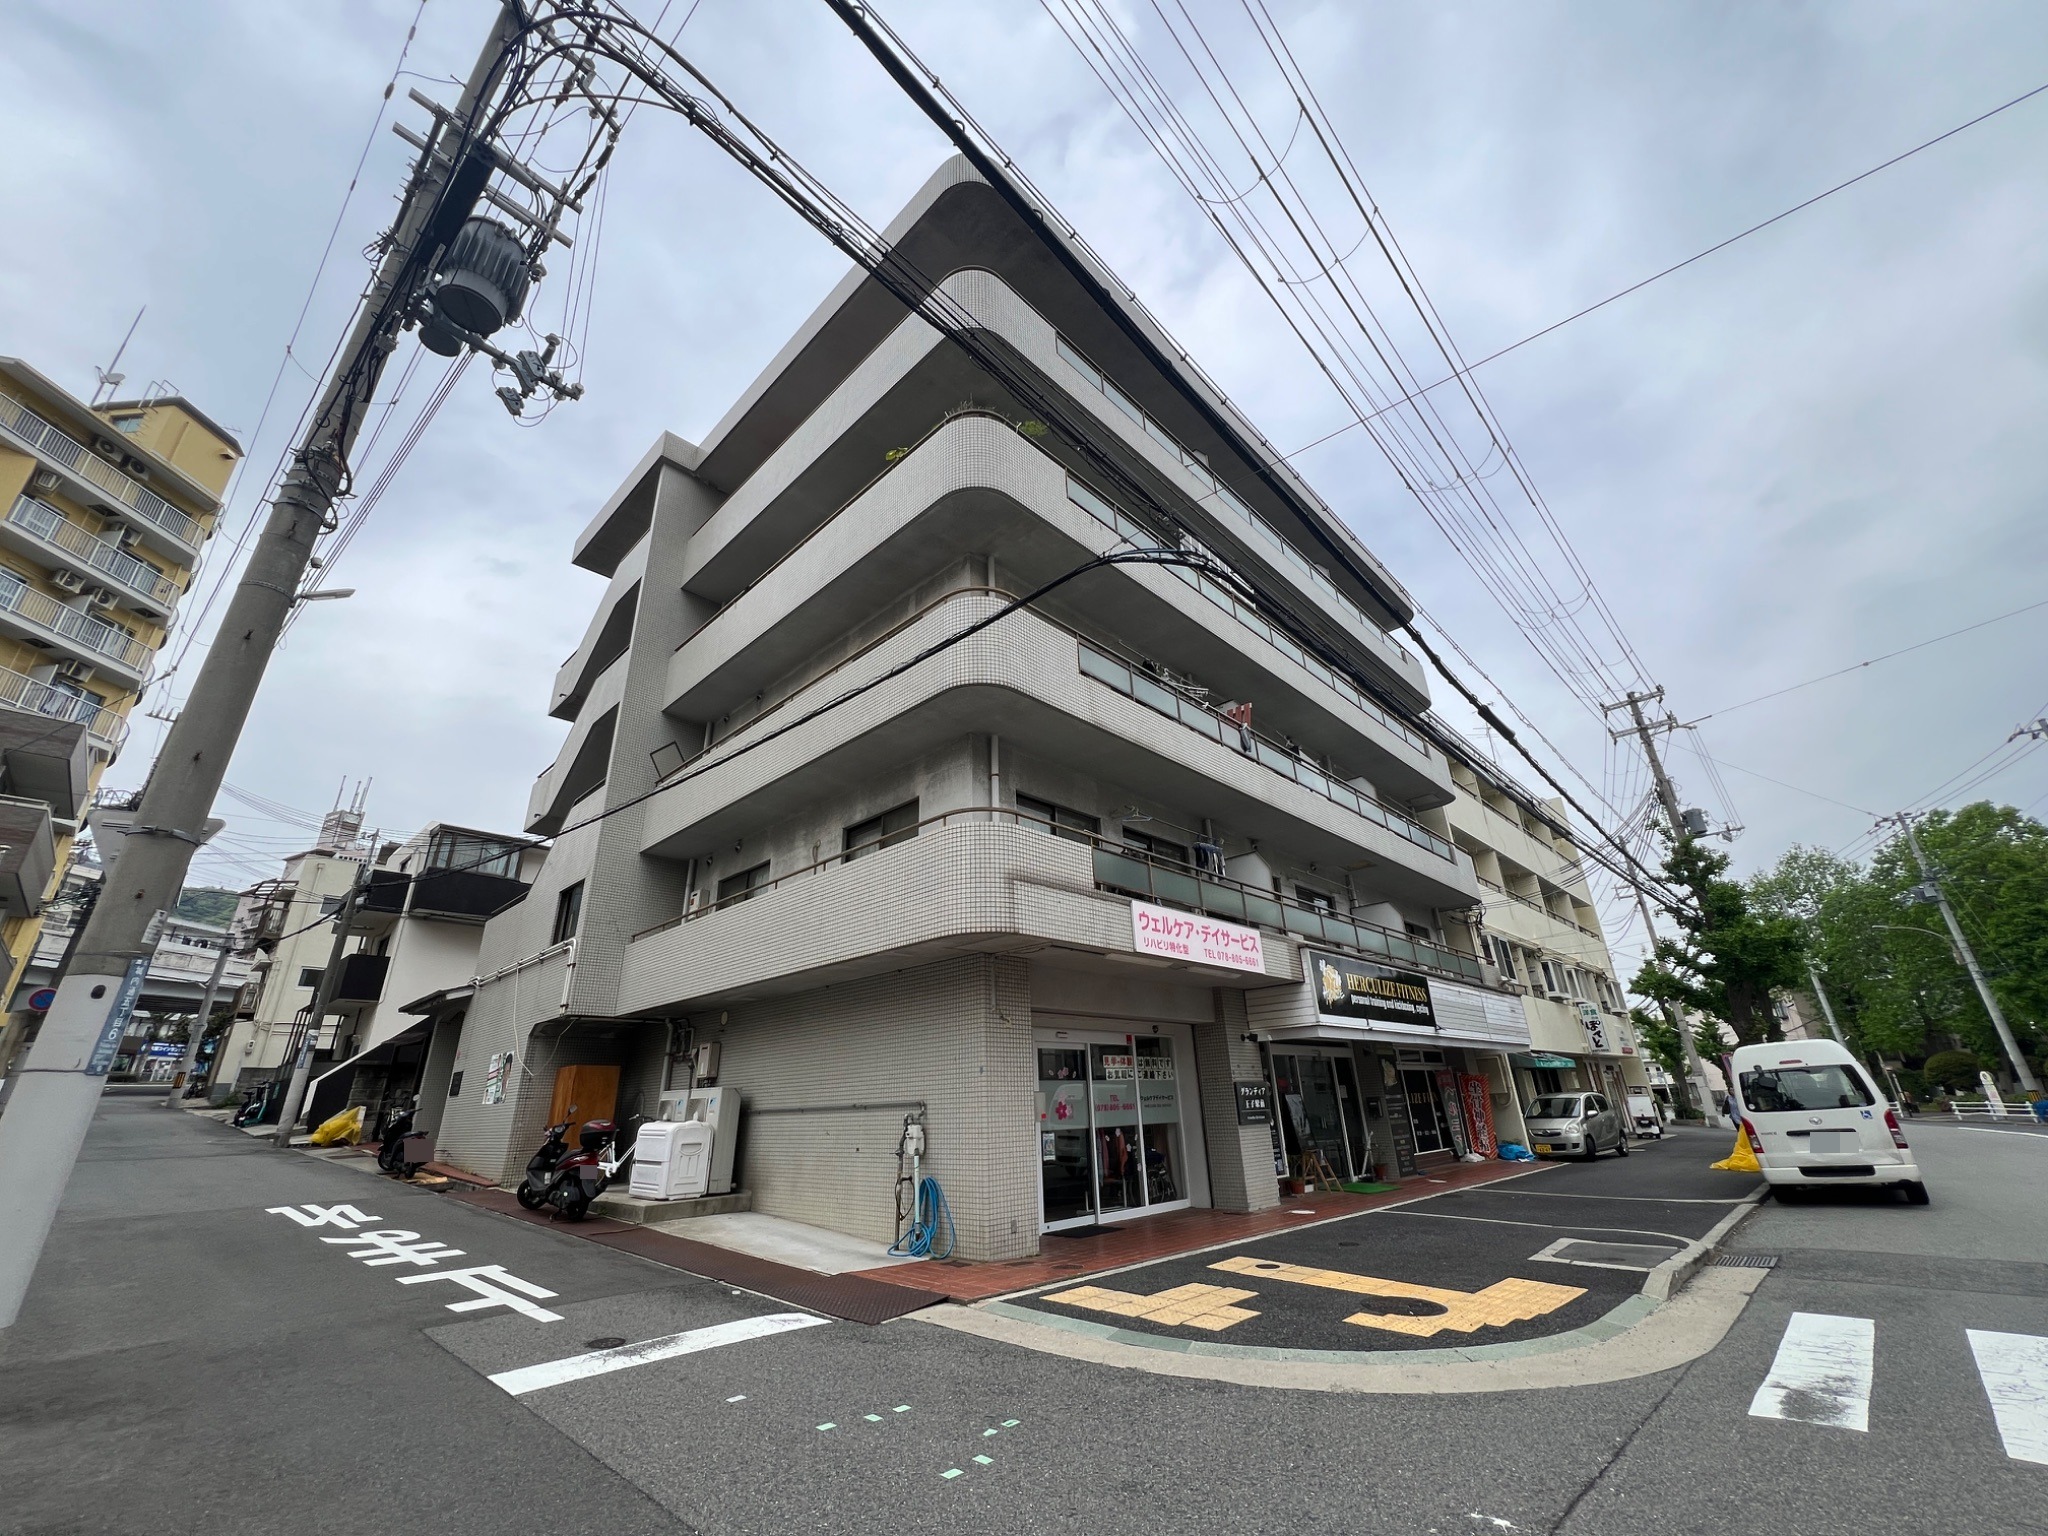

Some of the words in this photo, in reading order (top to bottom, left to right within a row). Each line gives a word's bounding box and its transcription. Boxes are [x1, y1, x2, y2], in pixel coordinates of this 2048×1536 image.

[1138, 911, 1259, 953] ウェルケア・デイサービス
[1143, 937, 1190, 955] リハビリ特化型
[1204, 949, 1217, 960] TEL
[1346, 973, 1397, 998] HERCULIZE
[1395, 983, 1428, 1003] FITNESS
[1584, 1020, 1604, 1048] ぽてと
[1468, 1080, 1491, 1154] 坐骨神経痛
